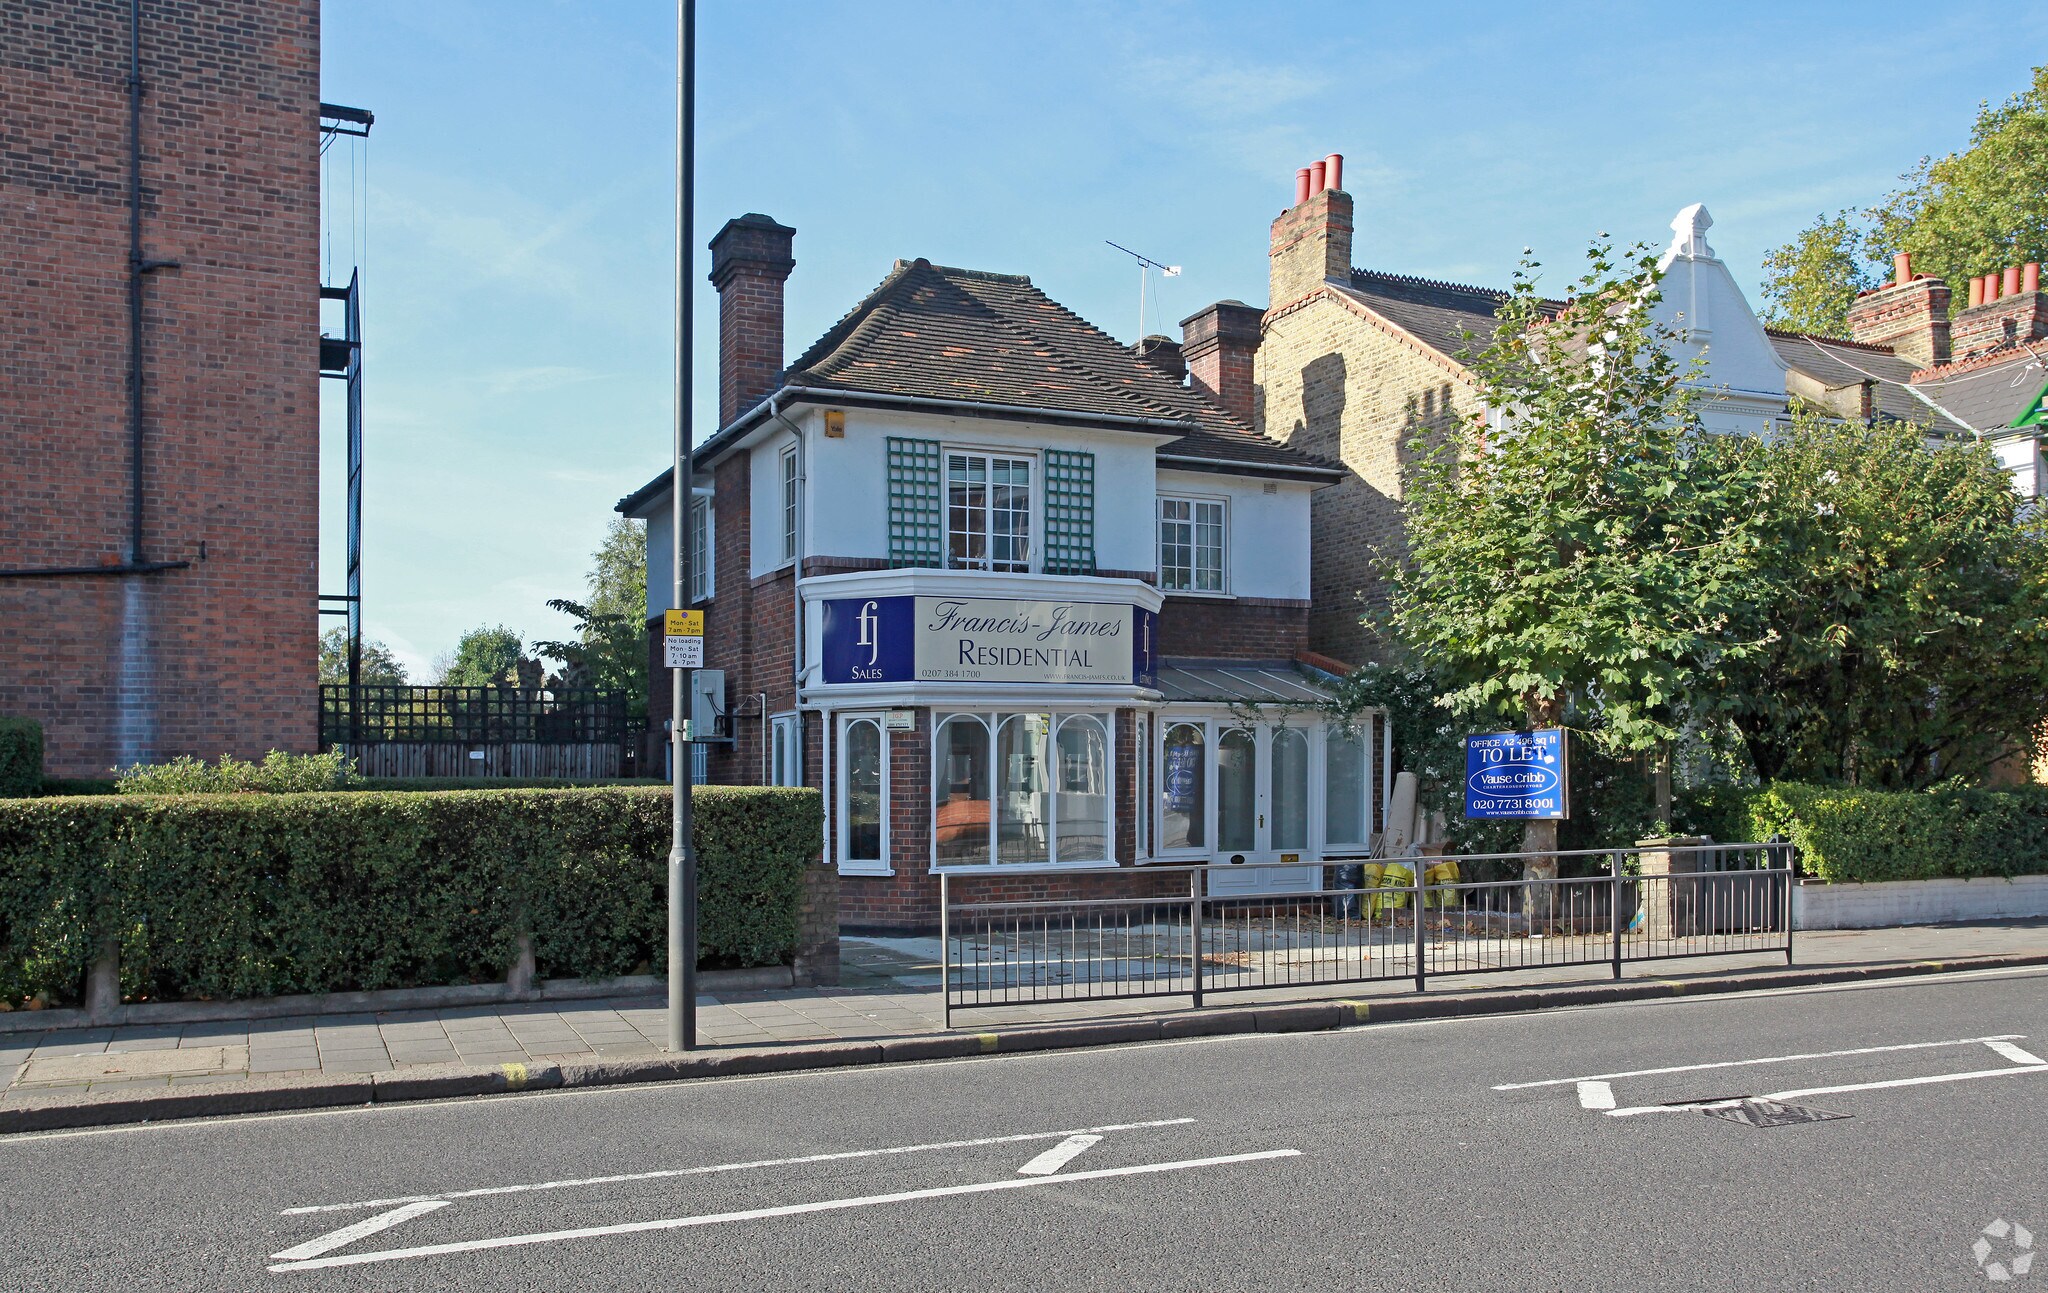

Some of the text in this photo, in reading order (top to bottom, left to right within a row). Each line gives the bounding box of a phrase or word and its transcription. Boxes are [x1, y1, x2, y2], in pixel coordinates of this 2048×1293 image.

[928, 602, 1121, 641] Francis-James
[958, 638, 1093, 668] RESIDENTIAL
[851, 665, 883, 680] SALES
[921, 668, 981, 680] 0207 384 1700
[1470, 735, 1556, 748] OFFICE A2 496 sq ft
[1479, 746, 1547, 763] TO LET
[1481, 772, 1546, 784] Vause Cribb
[1472, 798, 1554, 810] 020 7731 8001
